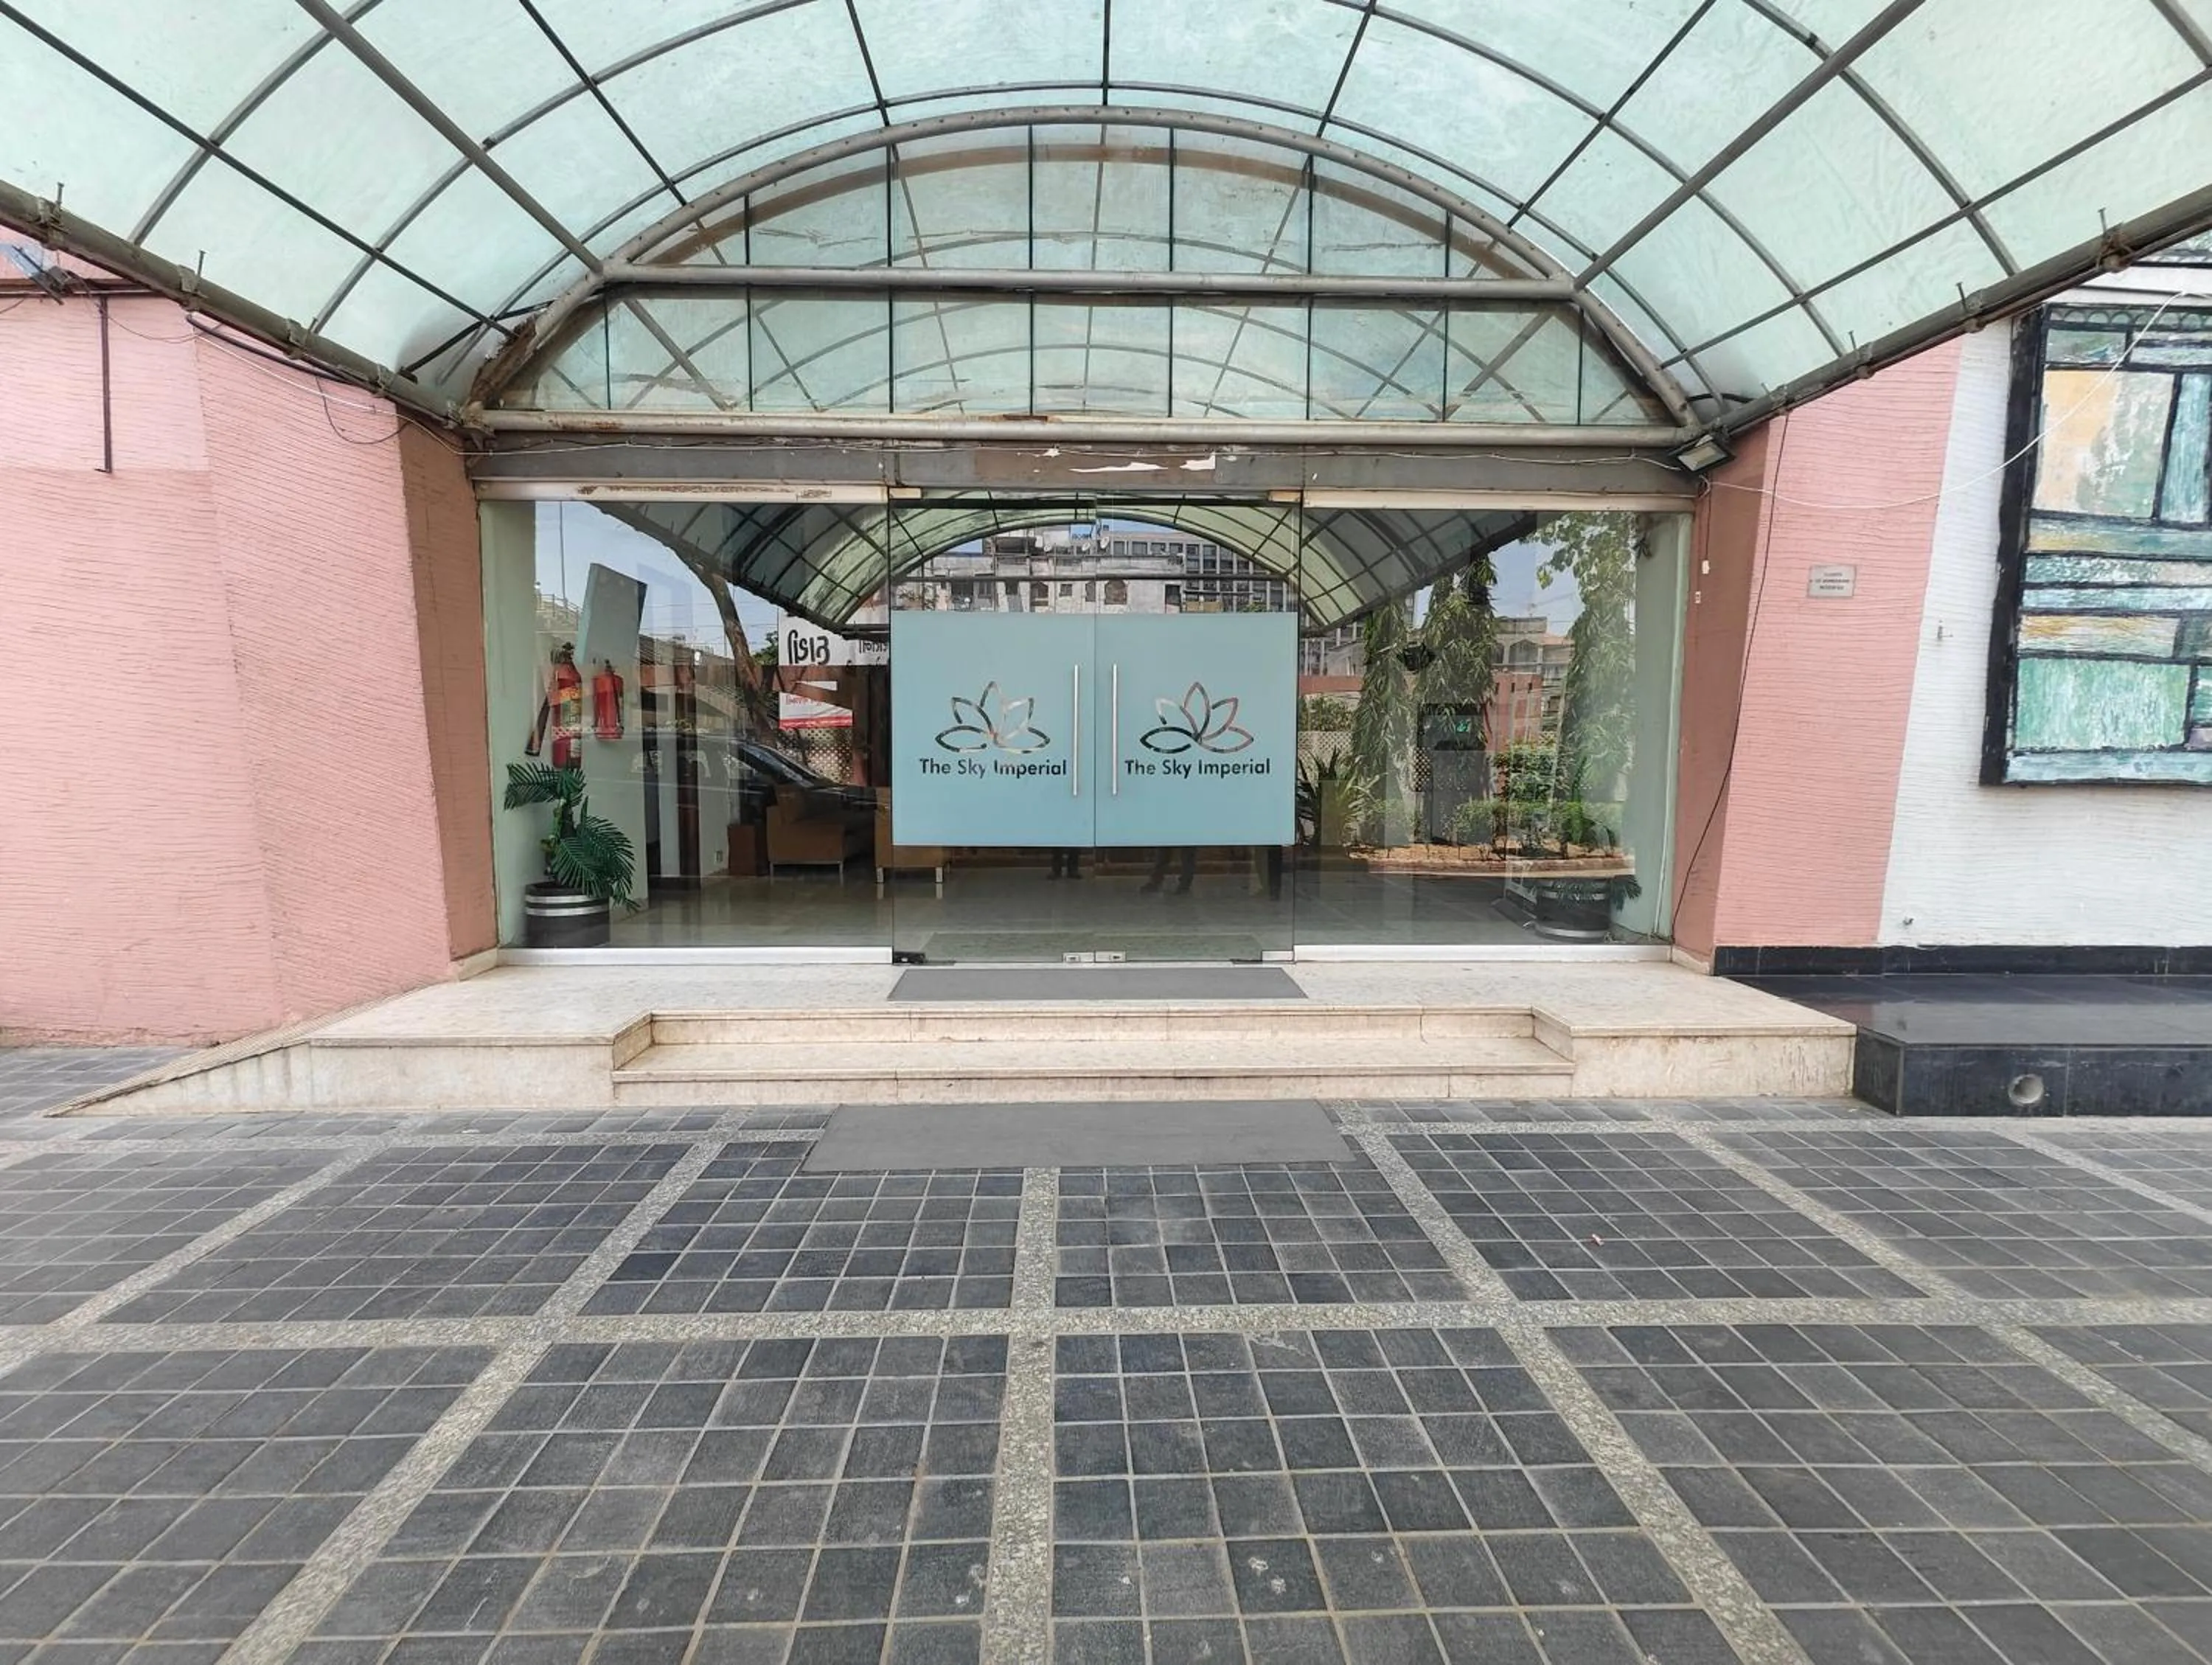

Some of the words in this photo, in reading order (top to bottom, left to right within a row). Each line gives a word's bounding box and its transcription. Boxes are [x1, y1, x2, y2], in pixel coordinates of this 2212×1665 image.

[919, 757, 952, 774] The
[957, 757, 986, 779] Sky
[993, 759, 1067, 779] Imperial
[1124, 758, 1157, 775] The
[1162, 758, 1192, 779] Sky
[1198, 757, 1270, 779] Imperial
